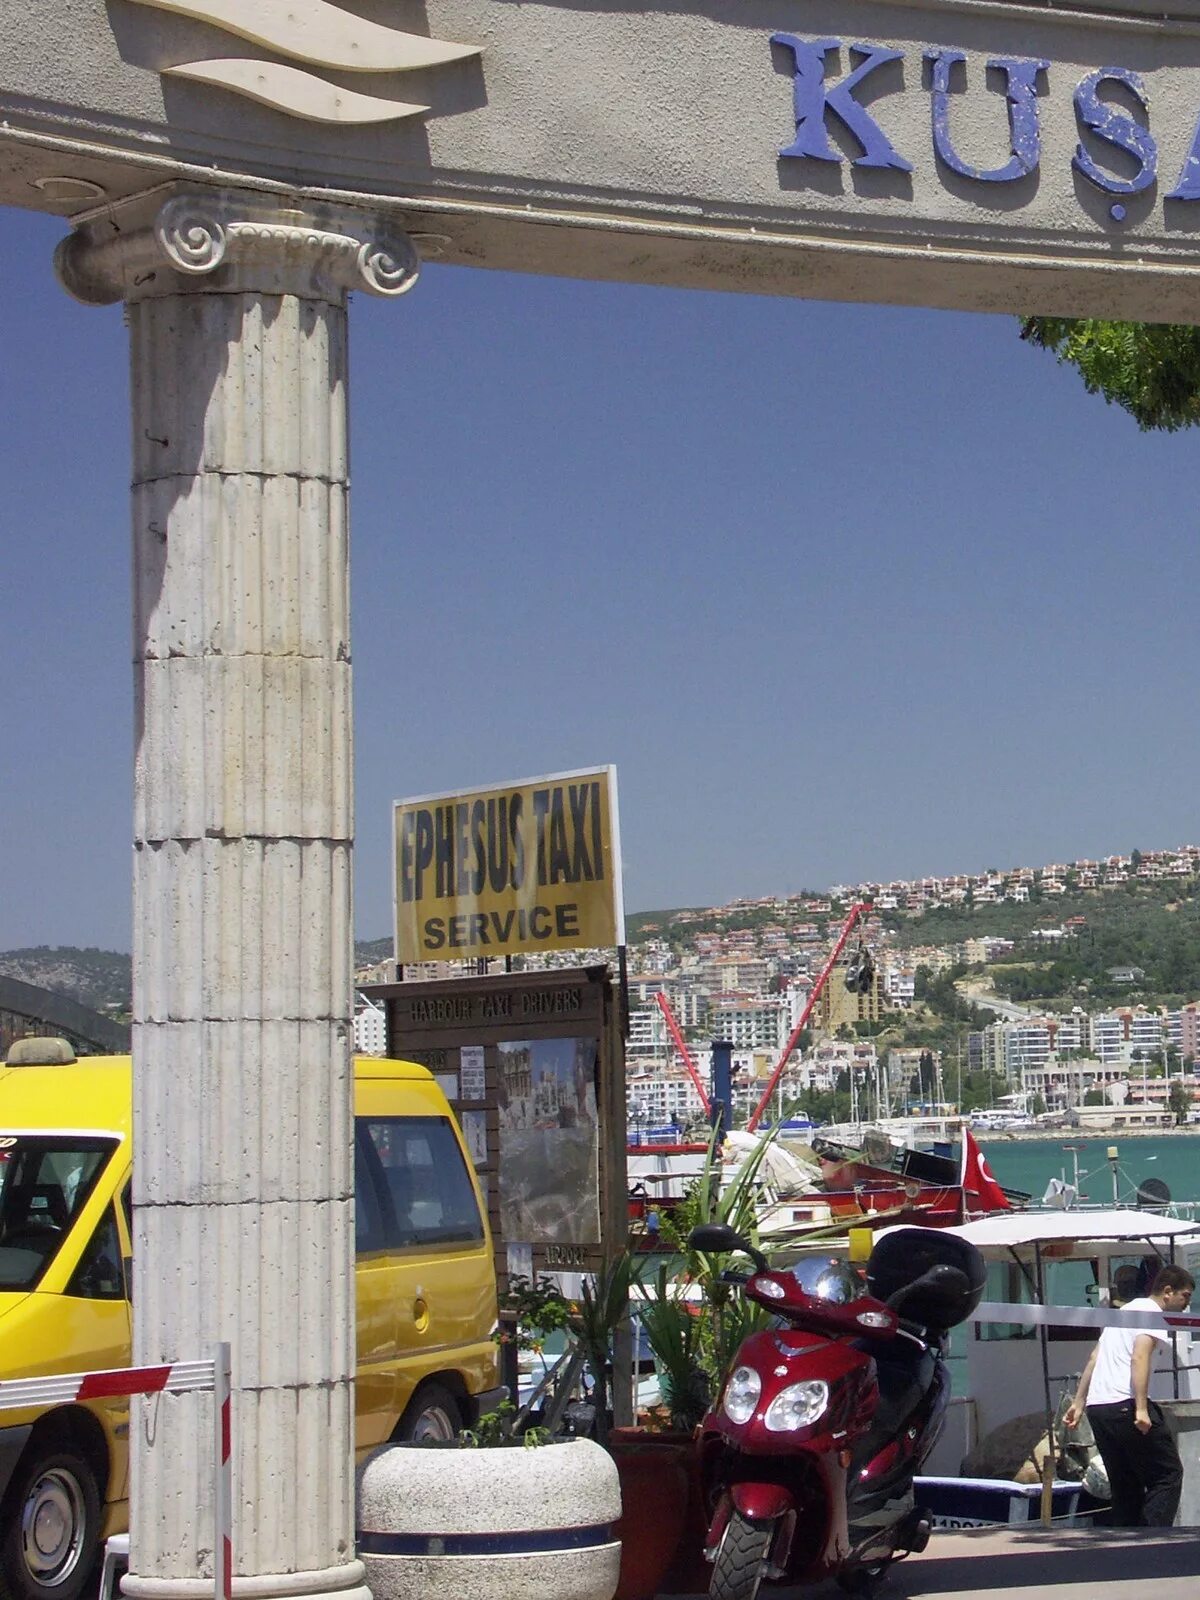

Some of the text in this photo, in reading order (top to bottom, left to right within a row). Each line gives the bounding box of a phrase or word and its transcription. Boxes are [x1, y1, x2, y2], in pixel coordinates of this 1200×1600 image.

[402, 782, 604, 903] EPHESUS TAXI
[423, 903, 580, 949] SERVICE
[410, 989, 581, 1022] HARBOUR TAXI DRIVERS
